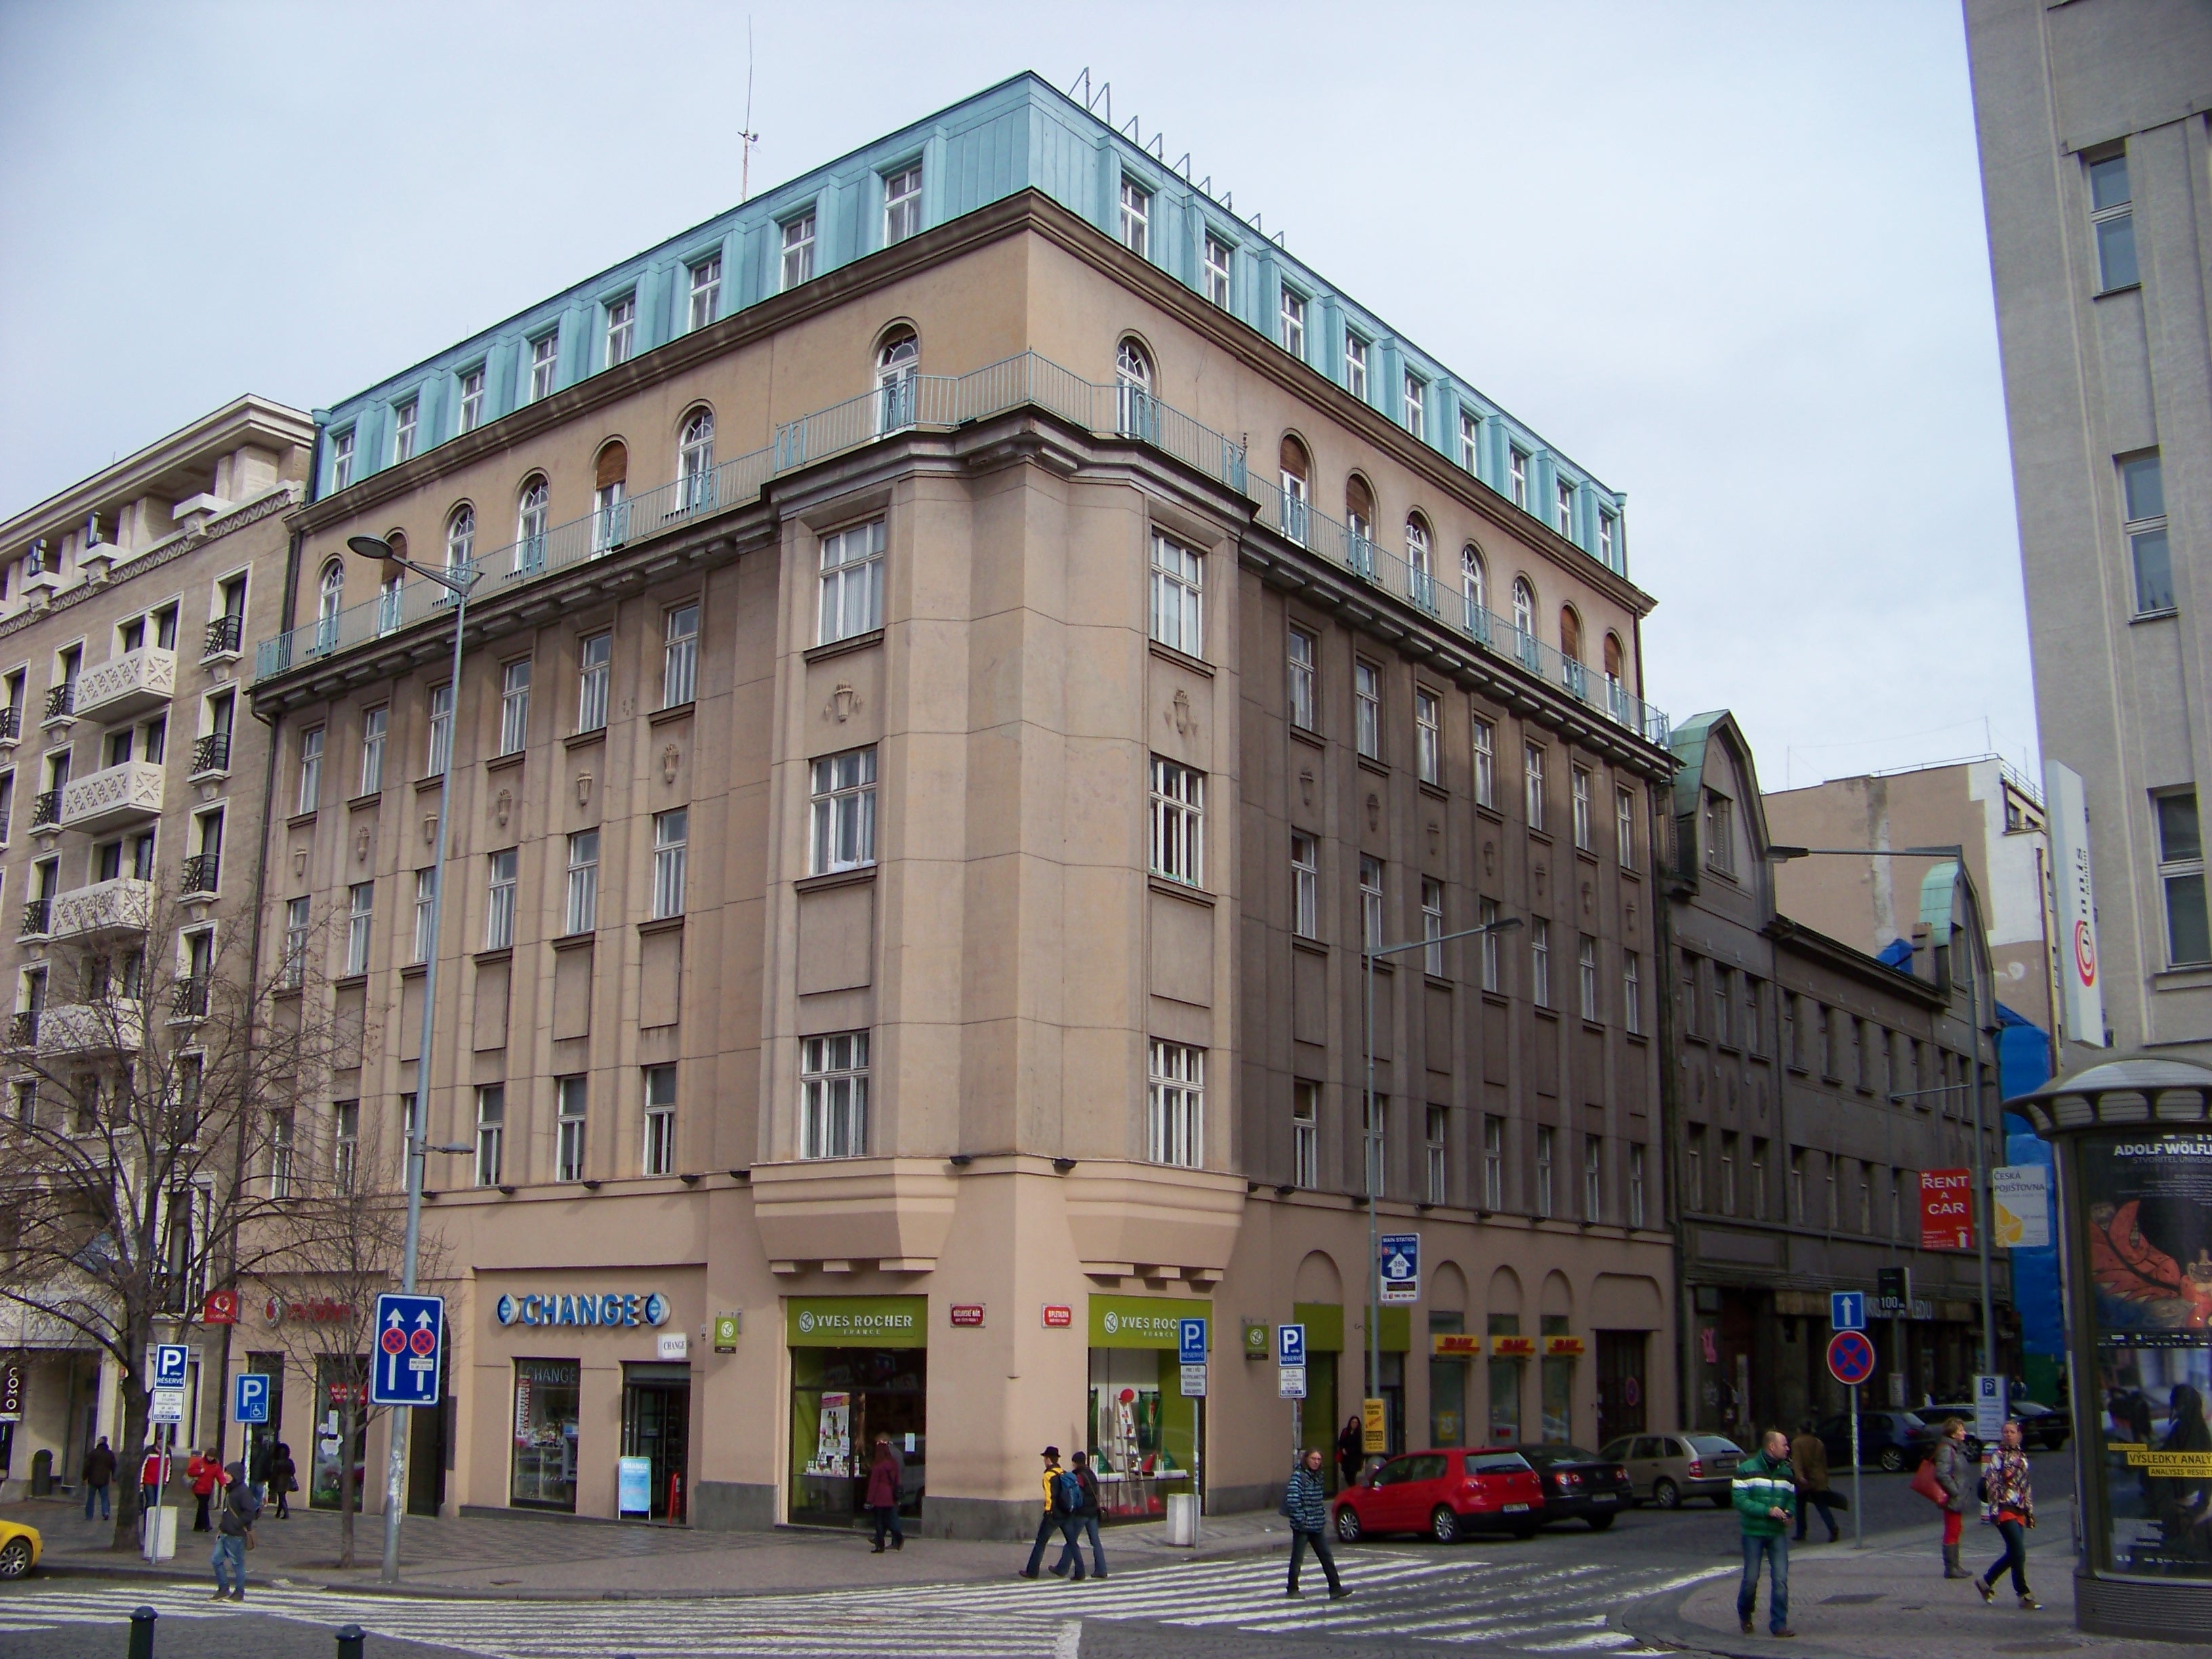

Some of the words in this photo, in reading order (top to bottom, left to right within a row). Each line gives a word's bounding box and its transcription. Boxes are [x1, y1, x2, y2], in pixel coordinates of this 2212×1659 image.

[2114, 1143, 2163, 1156] ADOLF
[1994, 1170, 2021, 1181] ČESKÁ
[1921, 1176, 1968, 1189] RENT
[1940, 1191, 1950, 1200] A
[1927, 1202, 1965, 1215] CAR
[1880, 1296, 1898, 1309] 100
[523, 1293, 640, 1326] CHANGE
[817, 1315, 850, 1326] YVES
[855, 1315, 912, 1326] ROCHER
[1122, 1316, 1150, 1329] YVES
[1153, 1317, 1179, 1330] ROC
[663, 1340, 686, 1351] CHANGE
[527, 1366, 576, 1383] CHANGE
[6, 1367, 19, 1410] COMO
[2129, 1452, 2177, 1464] VÝSLEDKY
